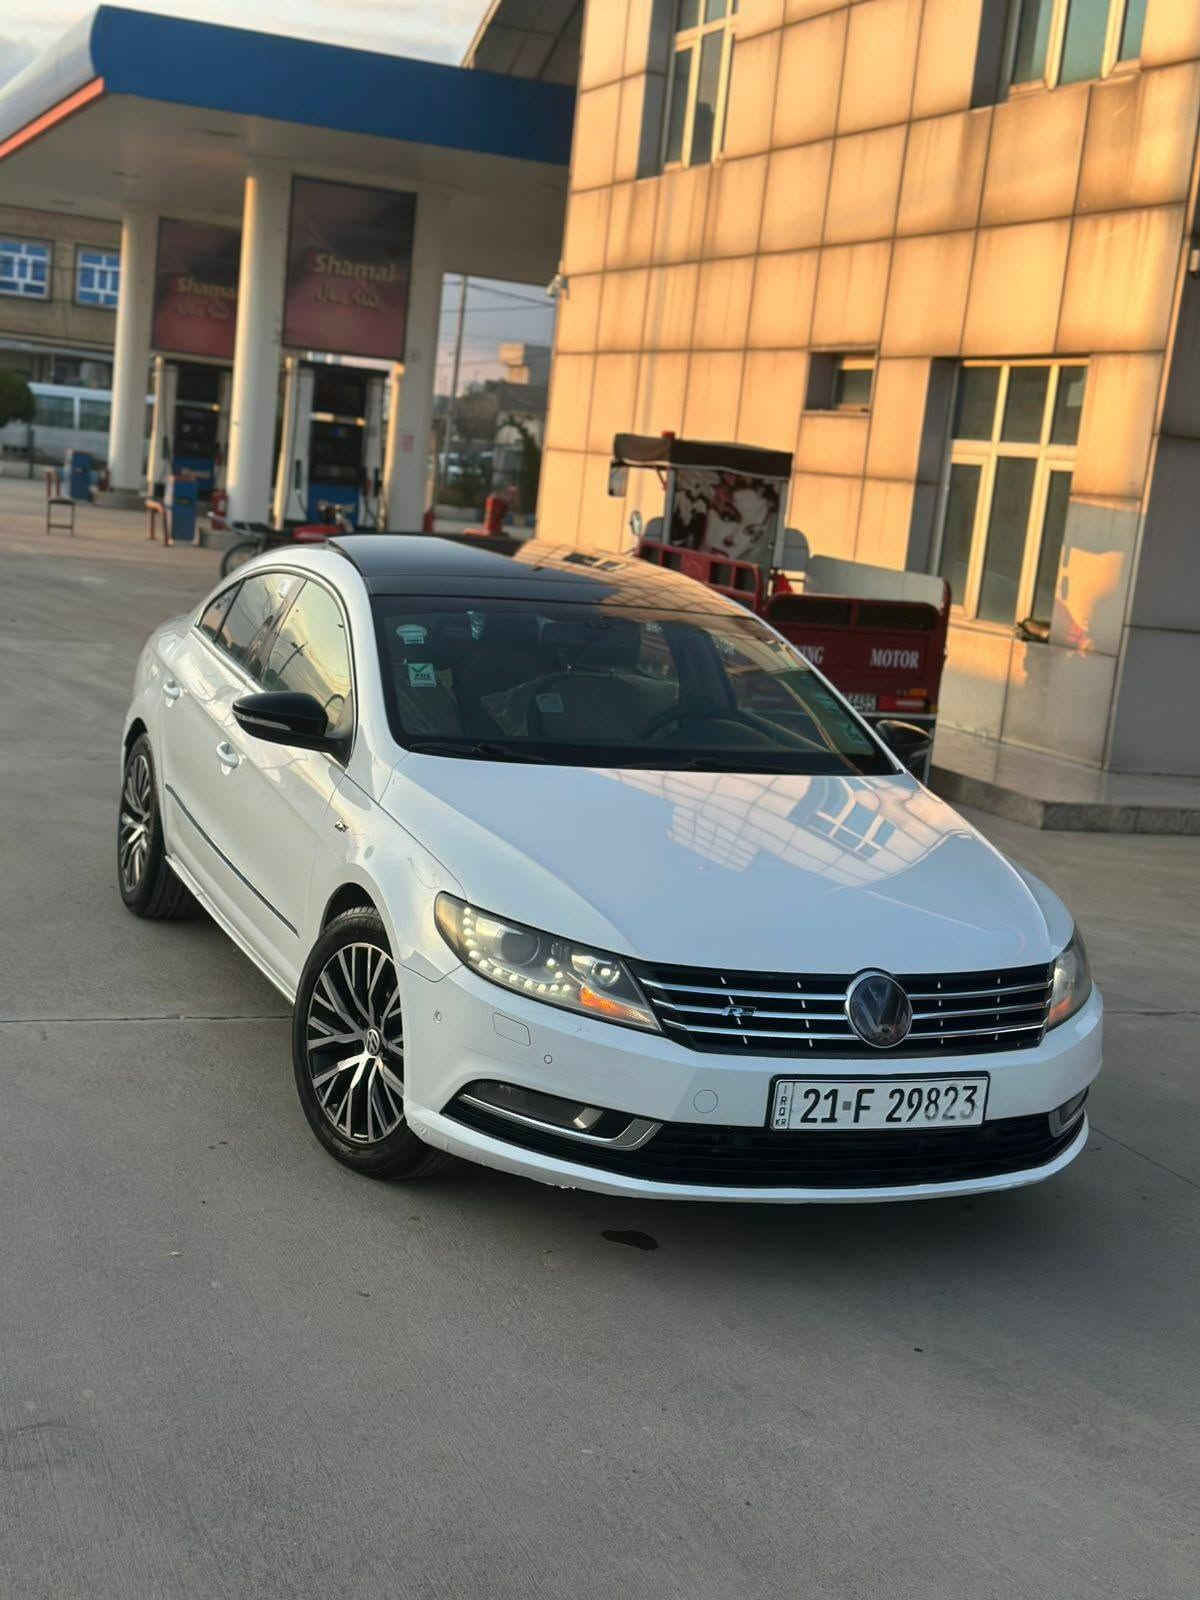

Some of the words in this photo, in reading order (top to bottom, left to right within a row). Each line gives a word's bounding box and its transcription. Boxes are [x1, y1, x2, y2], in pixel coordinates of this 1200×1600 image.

[314, 253, 396, 282] Shamal
[177, 276, 237, 299] Shama
[870, 648, 920, 668] MOTOR
[800, 1088, 839, 1123] 21
[853, 1088, 875, 1123] F
[885, 1085, 978, 1123] 29823
